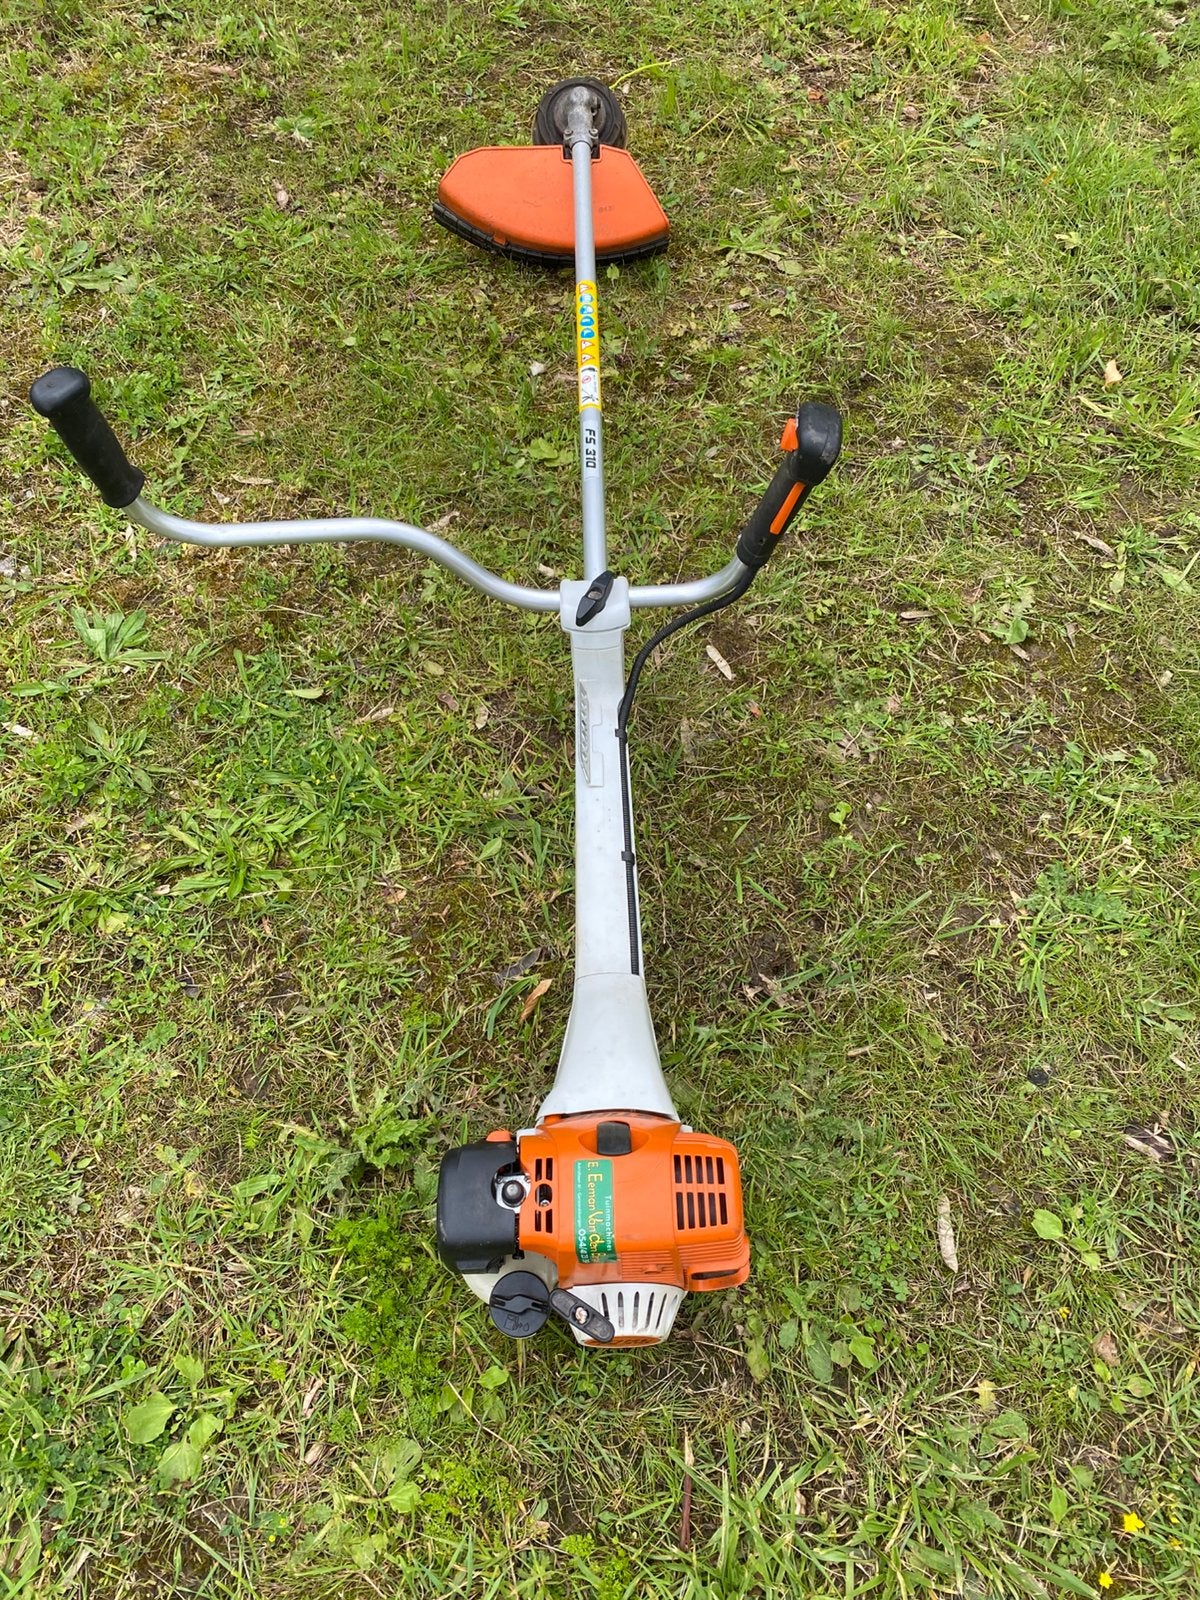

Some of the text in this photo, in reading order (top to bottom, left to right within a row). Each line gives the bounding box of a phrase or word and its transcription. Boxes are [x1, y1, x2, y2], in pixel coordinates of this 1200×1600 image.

[585, 428, 596, 469] FS 310
[588, 1161, 599, 1171] E.
[588, 1173, 603, 1211] Eeman
[588, 1211, 604, 1234] Van
